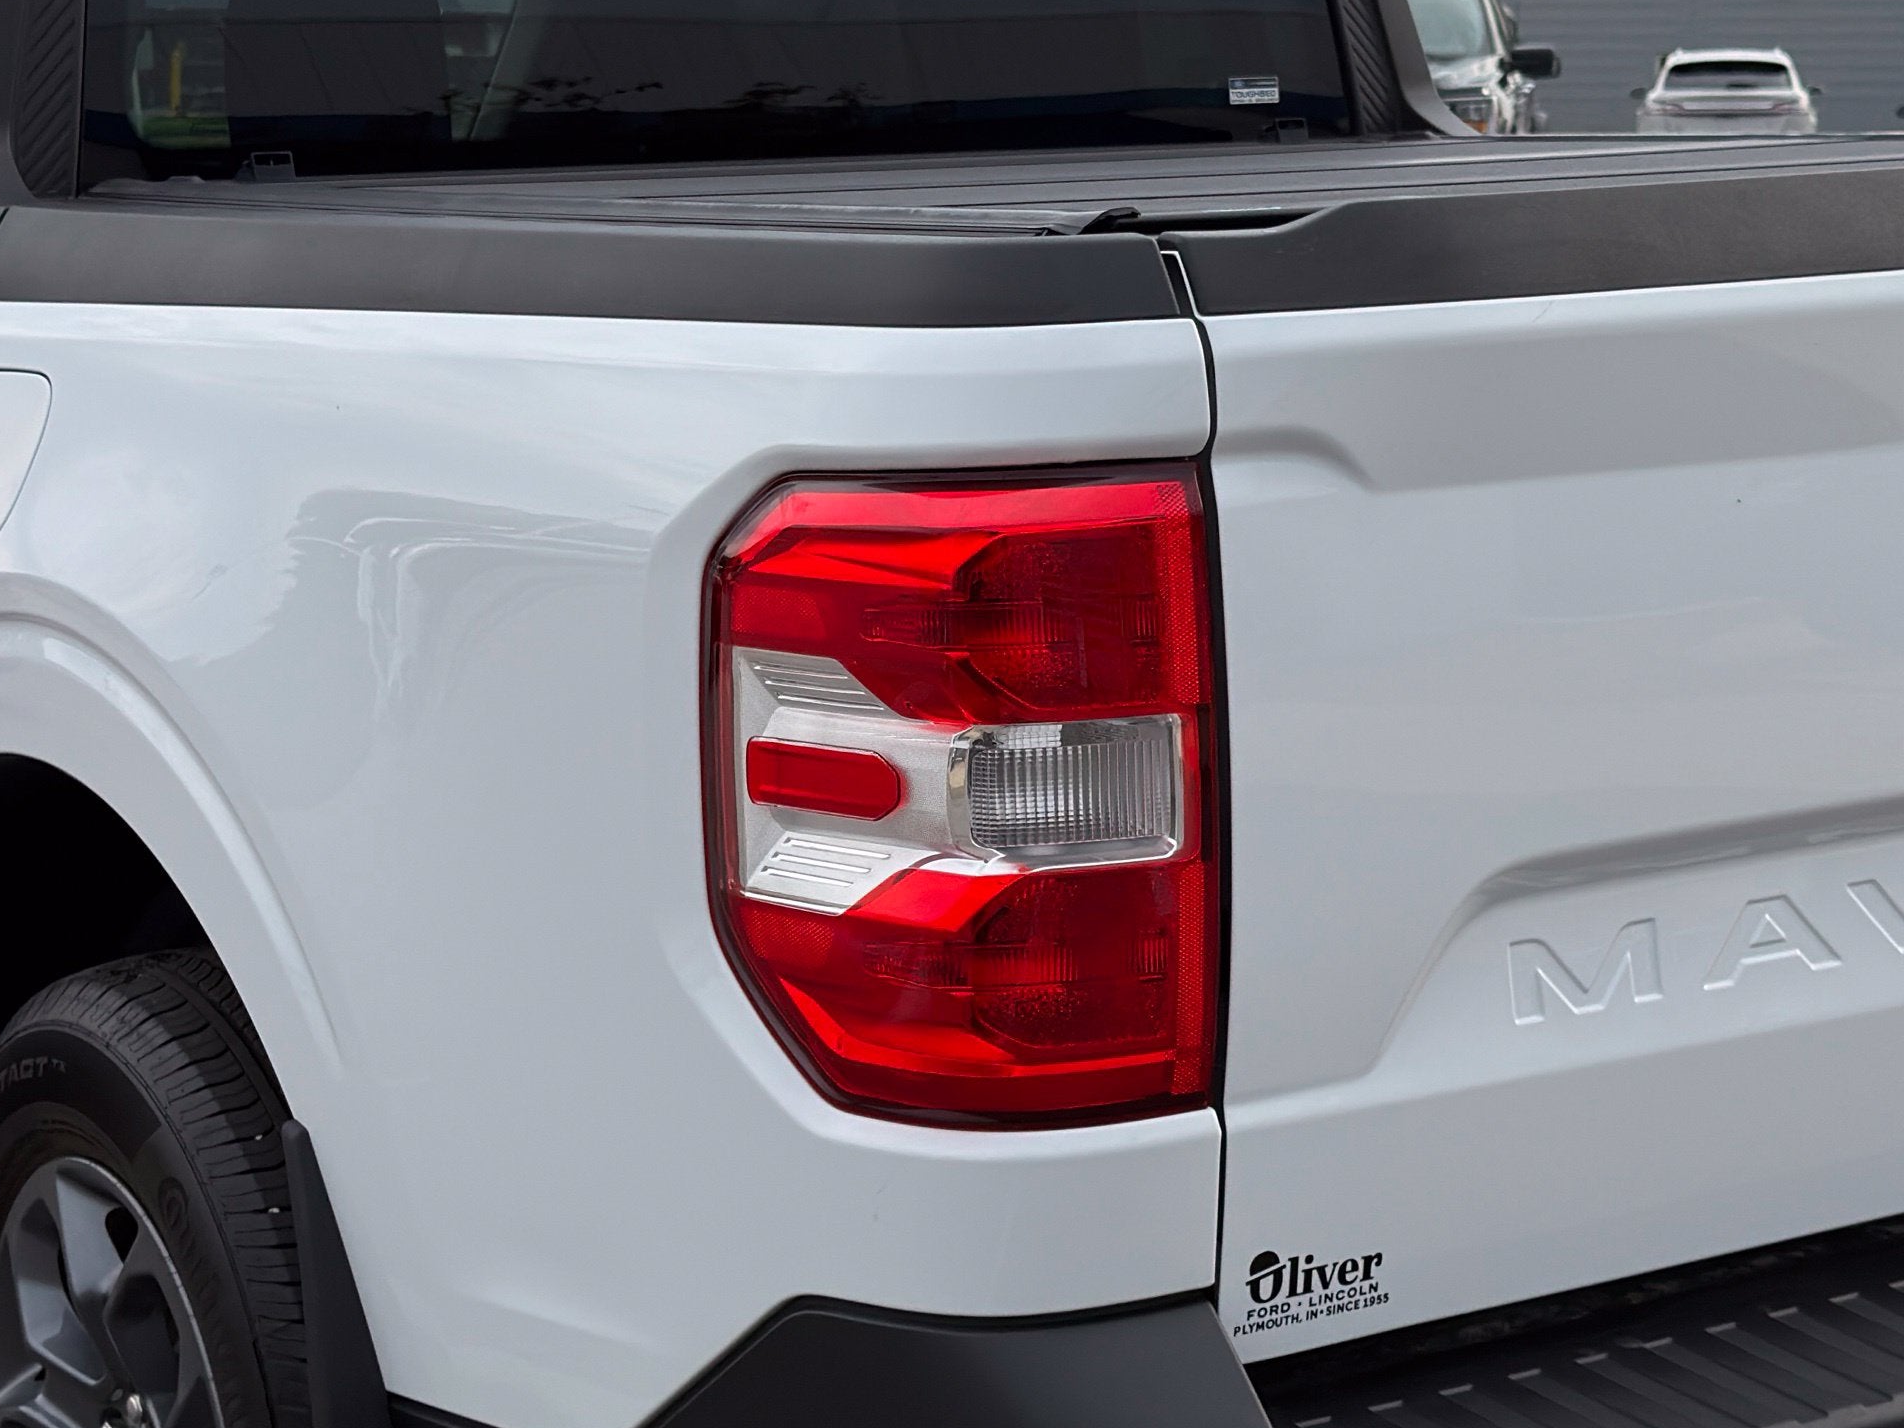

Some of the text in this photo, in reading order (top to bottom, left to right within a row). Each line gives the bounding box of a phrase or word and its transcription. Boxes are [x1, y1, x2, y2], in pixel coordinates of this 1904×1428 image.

[1245, 1250, 1383, 1304] Oliver
[1233, 1313, 1302, 1337] PLYMOUTH,
[1363, 1292, 1390, 1308] 1955
[1246, 1282, 1379, 1321] FORD LINCOLN
